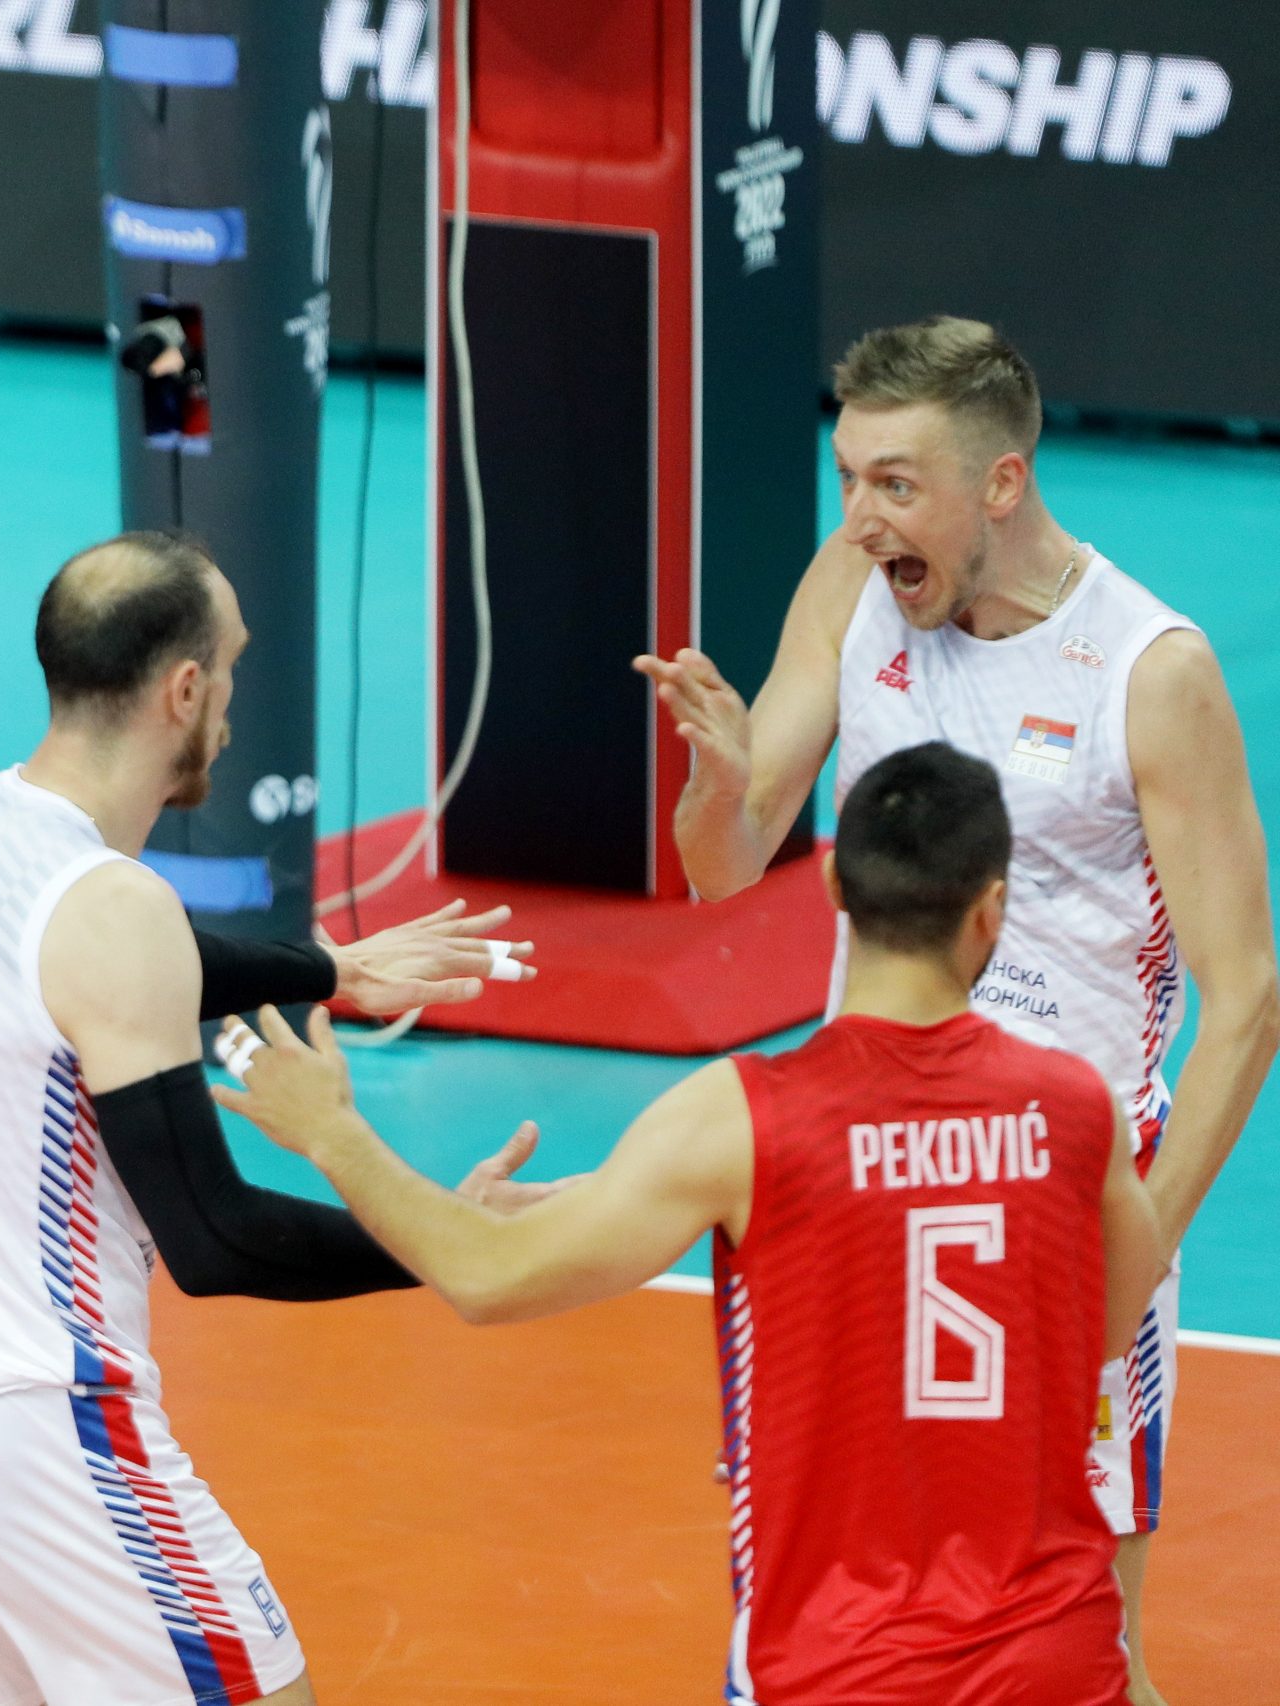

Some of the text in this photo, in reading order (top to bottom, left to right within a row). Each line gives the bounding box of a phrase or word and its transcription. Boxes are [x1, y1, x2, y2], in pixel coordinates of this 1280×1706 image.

[816, 28, 1232, 168] NSHIP
[973, 985, 1061, 1018] ИОНИЦА
[986, 960, 1047, 989] НСКА
[848, 1100, 1051, 1191] PEKOVIĆ
[904, 1202, 1005, 1420] 6
